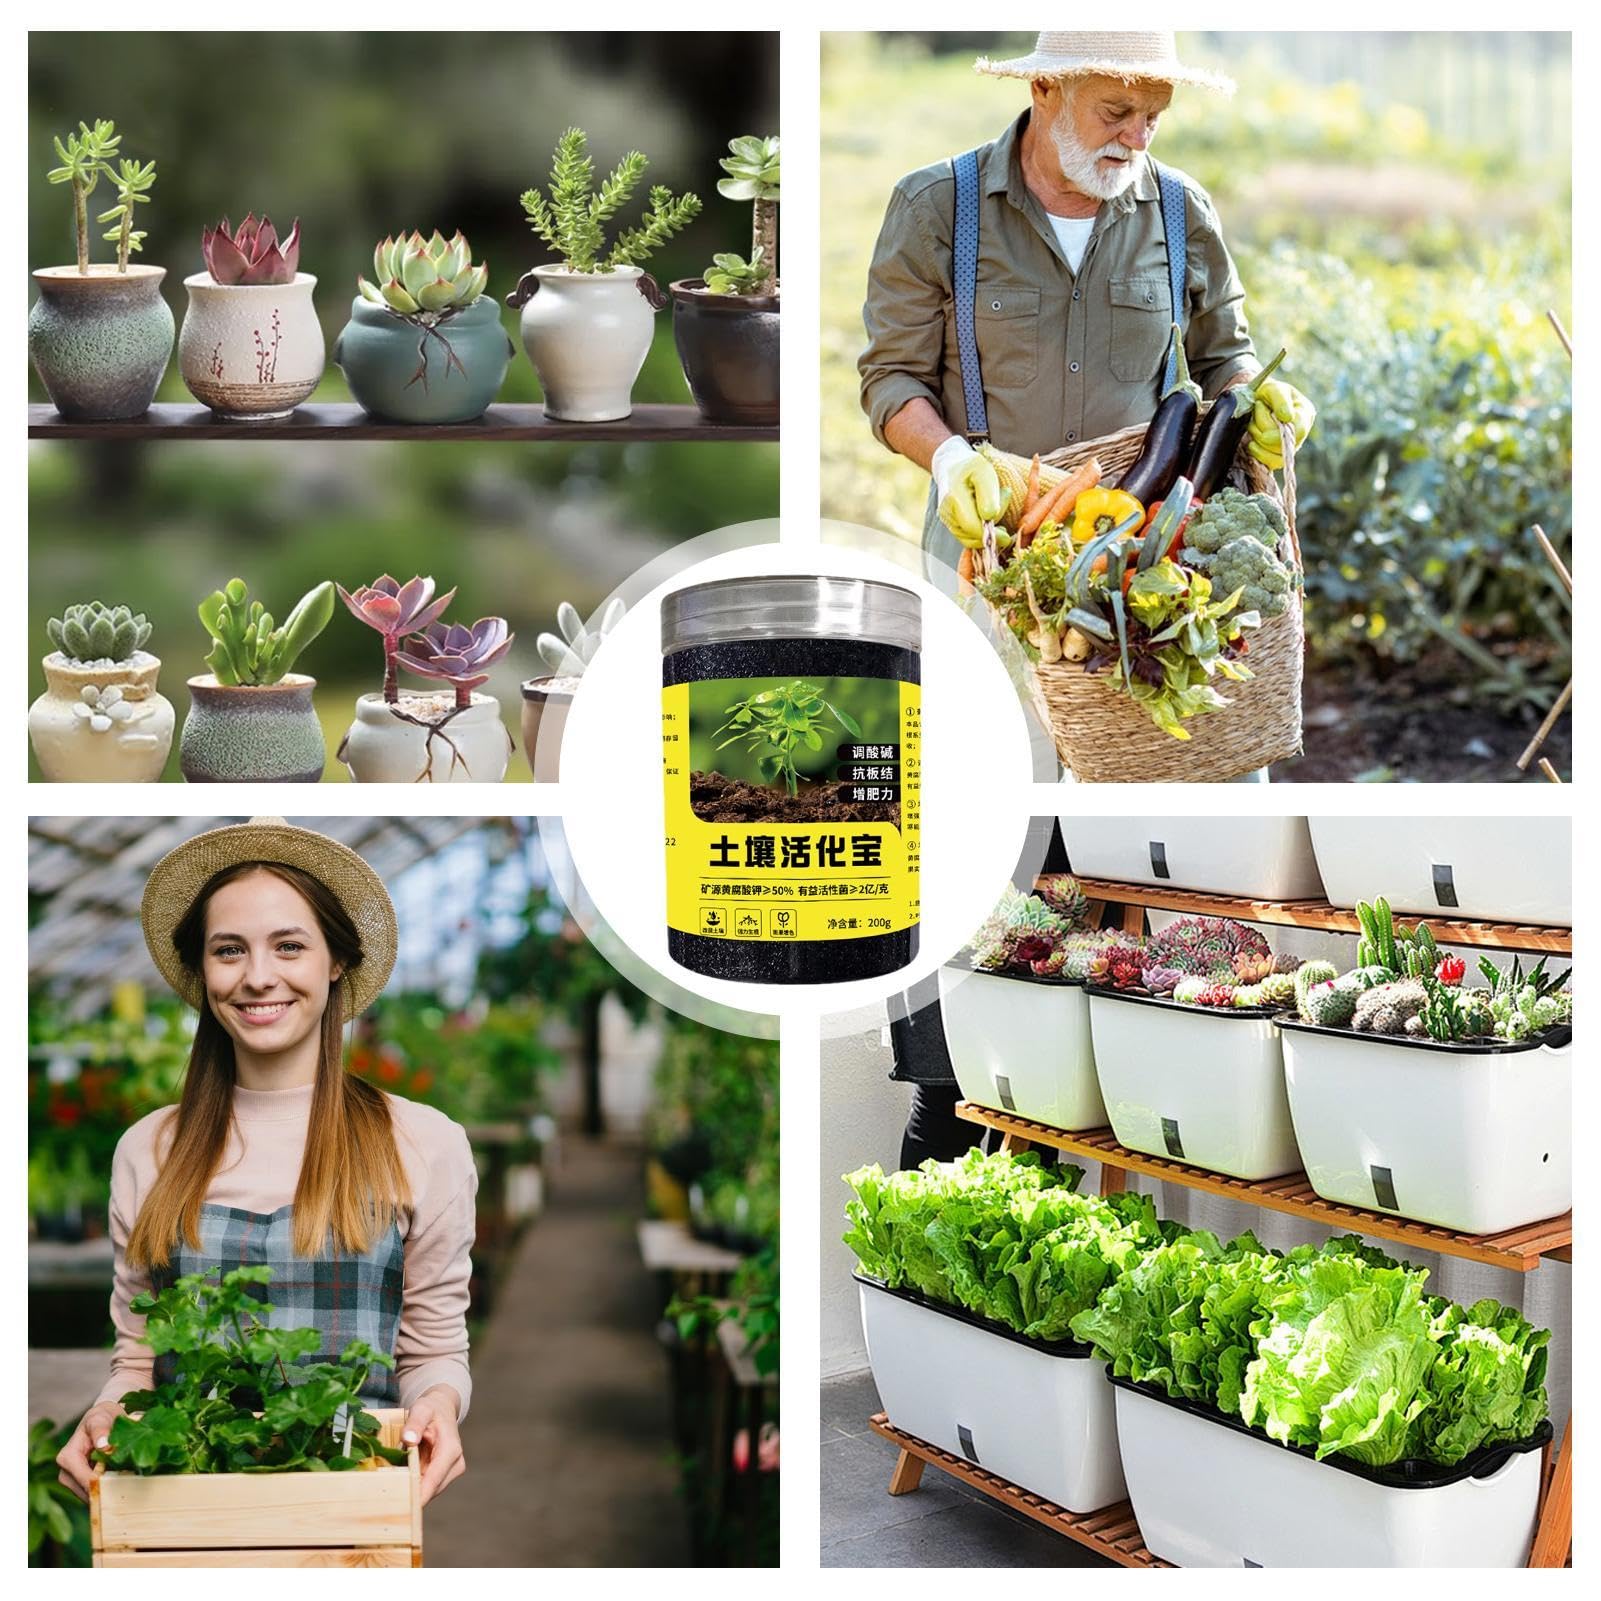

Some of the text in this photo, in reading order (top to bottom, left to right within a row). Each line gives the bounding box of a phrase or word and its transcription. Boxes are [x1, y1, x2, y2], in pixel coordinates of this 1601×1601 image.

[852, 745, 894, 760] 调酸碱
[852, 766, 894, 780] 抗板结
[852, 787, 894, 802] 增肥力
[709, 834, 882, 868] 土壤活化宝
[868, 918, 892, 929] 200g
